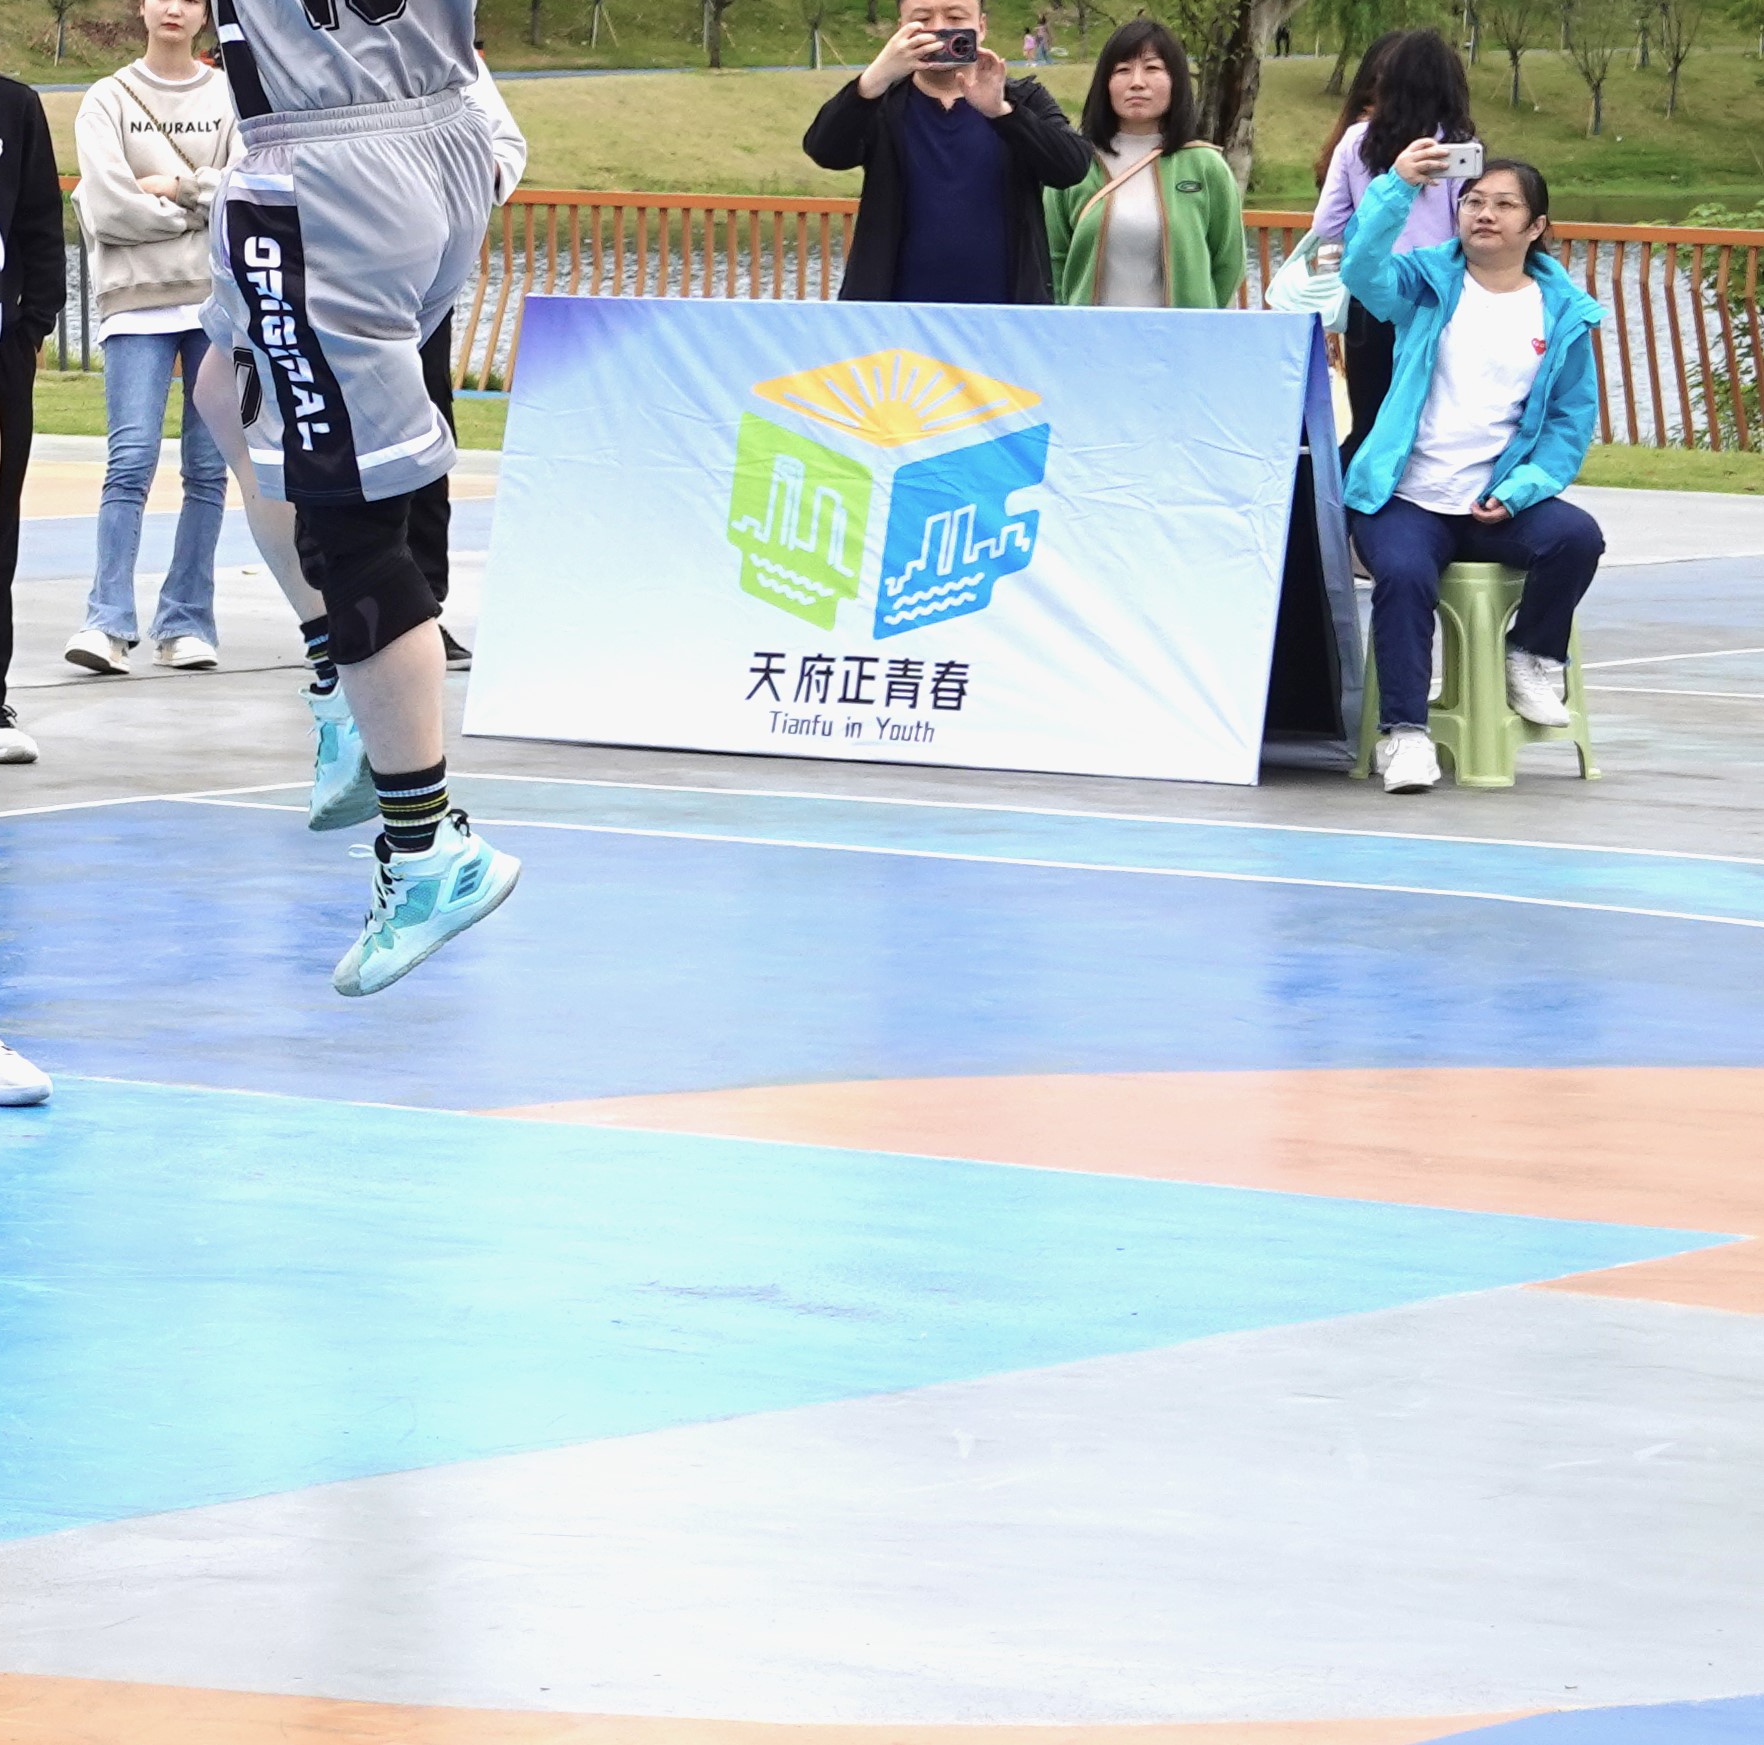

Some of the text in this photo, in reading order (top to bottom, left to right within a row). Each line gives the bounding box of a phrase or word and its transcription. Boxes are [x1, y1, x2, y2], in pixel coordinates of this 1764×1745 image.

[130, 118, 222, 134] NAURALLY
[744, 651, 970, 712] 天府正青春
[769, 710, 936, 744] Tianfu in Youth
